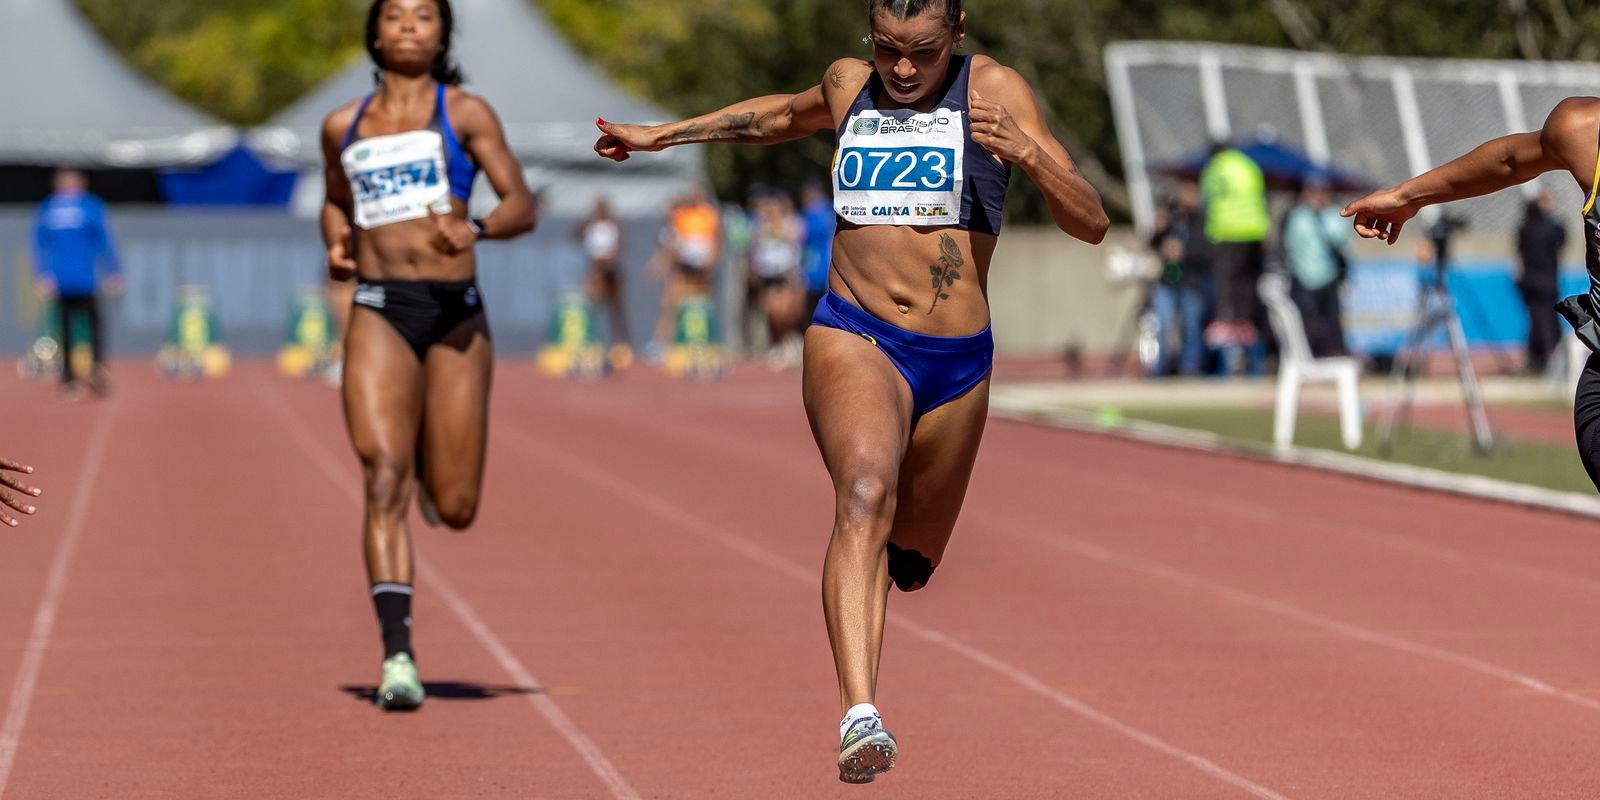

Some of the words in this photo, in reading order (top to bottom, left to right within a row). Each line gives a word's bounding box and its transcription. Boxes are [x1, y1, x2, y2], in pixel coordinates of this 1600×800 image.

[881, 117, 950, 128] ATLETISMO
[880, 125, 924, 134] BRASIL
[839, 151, 947, 189] 0723
[871, 206, 910, 216] CAIXA
